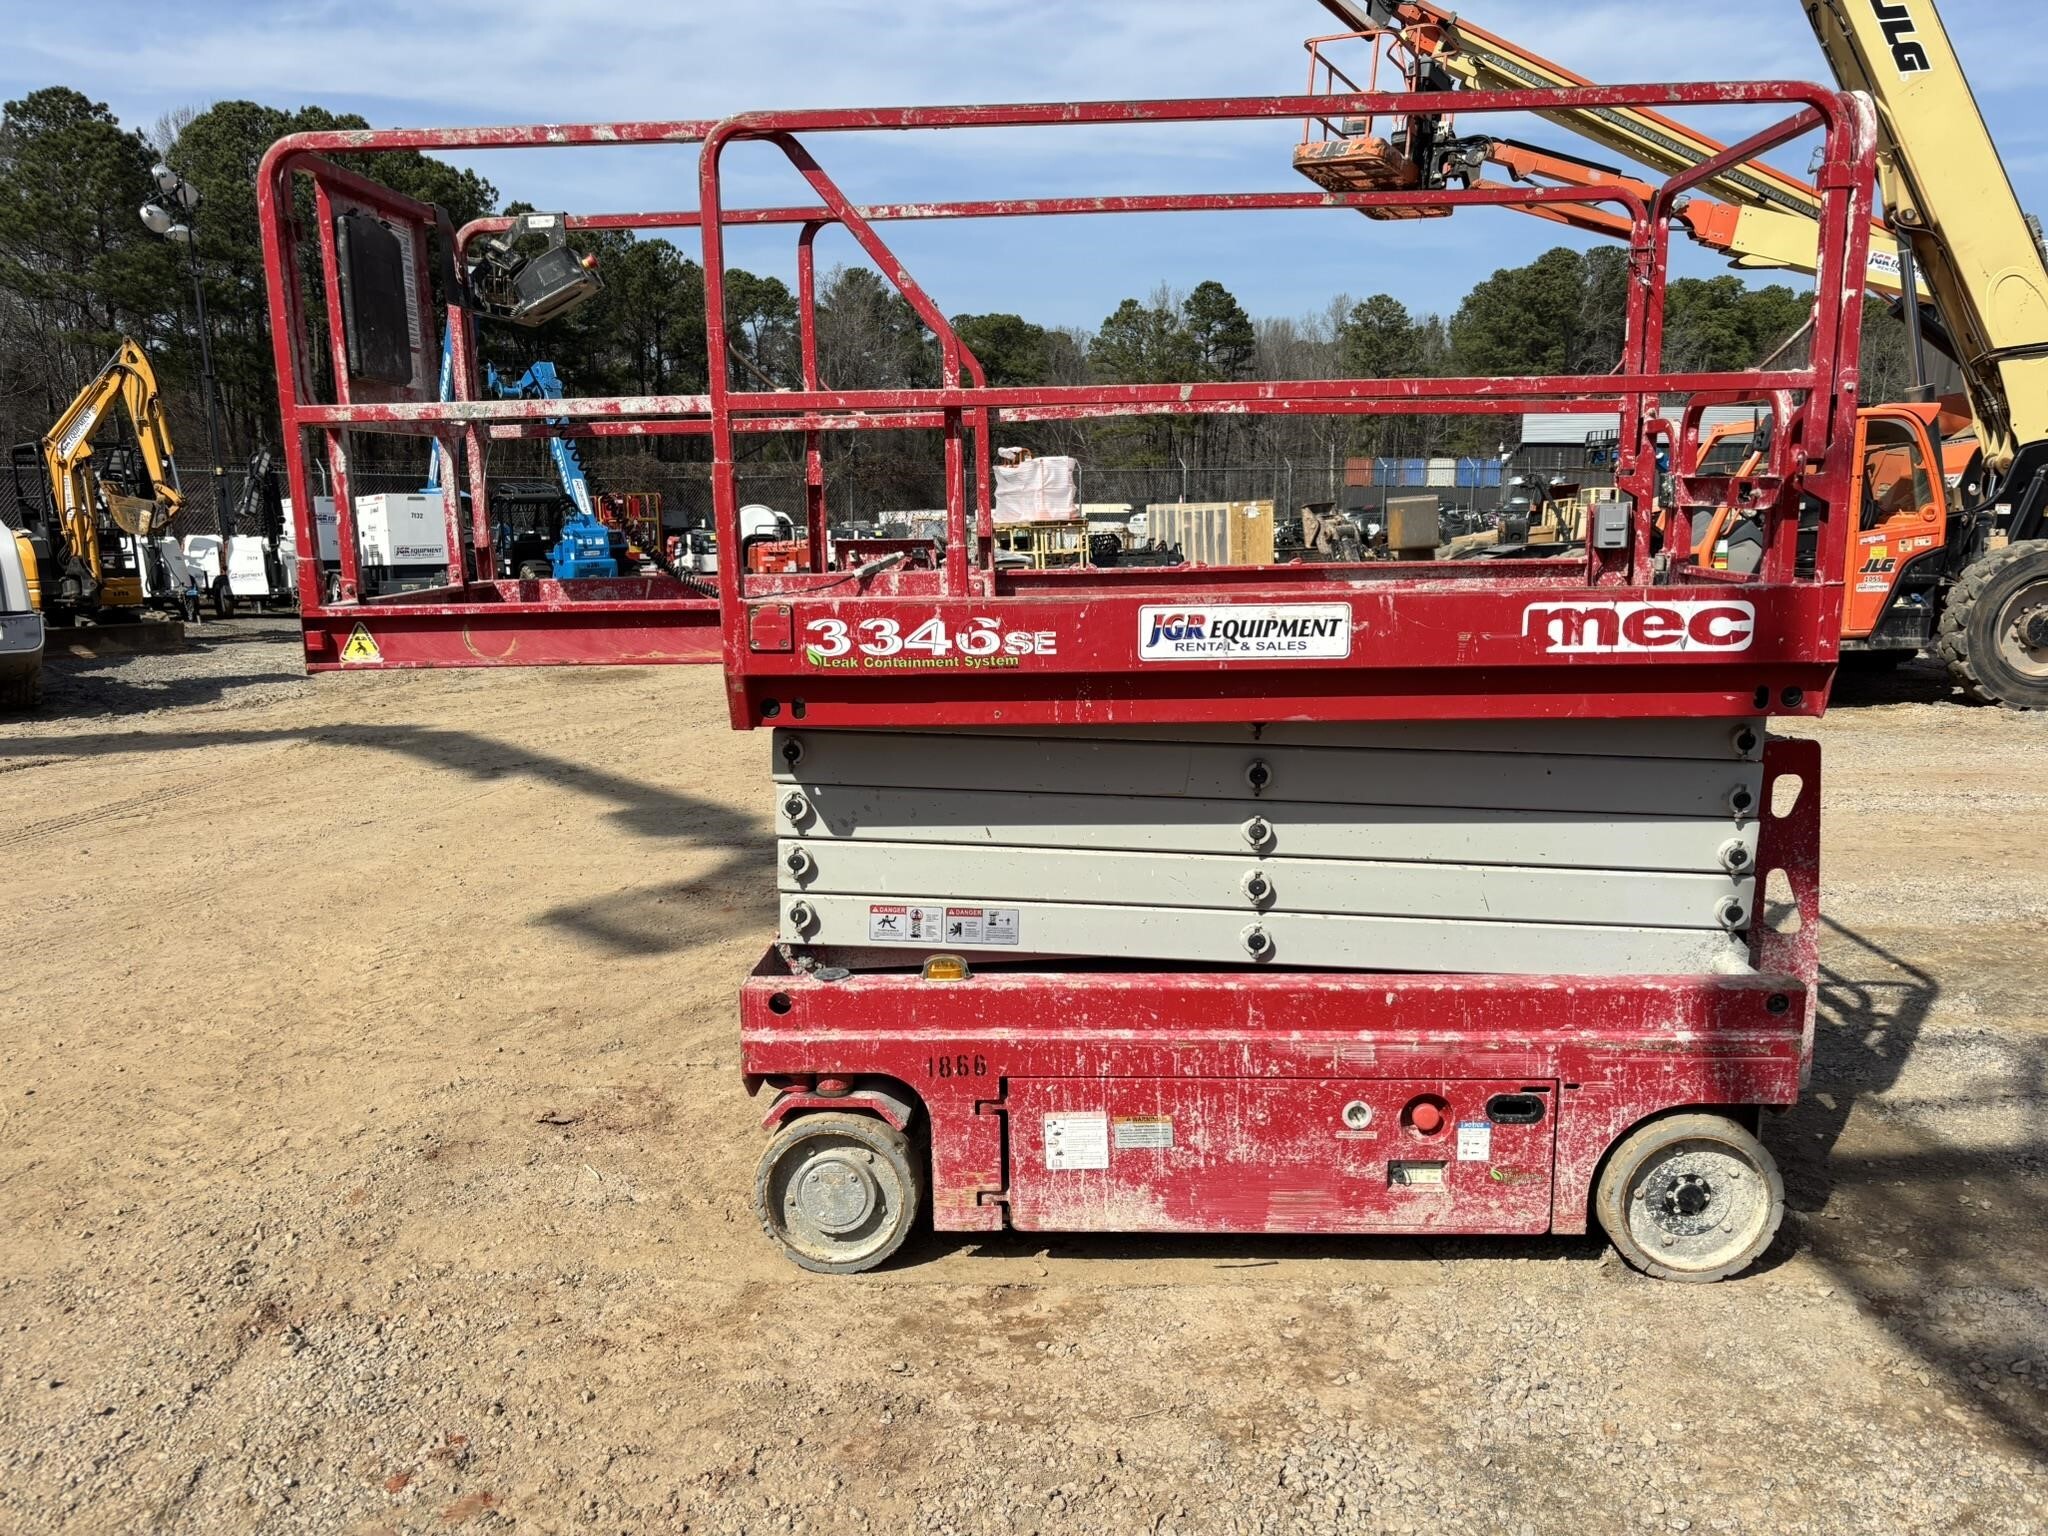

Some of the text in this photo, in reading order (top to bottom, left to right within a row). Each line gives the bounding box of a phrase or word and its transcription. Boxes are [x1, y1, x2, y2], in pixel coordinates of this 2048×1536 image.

[1869, 0, 1931, 72] JLG
[410, 547, 442, 555] EQUIPMENT
[1859, 558, 1896, 573] JLG
[1146, 613, 1343, 648] JGR EQUIPMENT
[1527, 606, 1752, 648] mec
[1175, 640, 1307, 651] RENTAL & SALES
[822, 655, 1020, 670] Leak Containment System
[879, 906, 906, 914] DANGER
[928, 1054, 988, 1078] 1866
